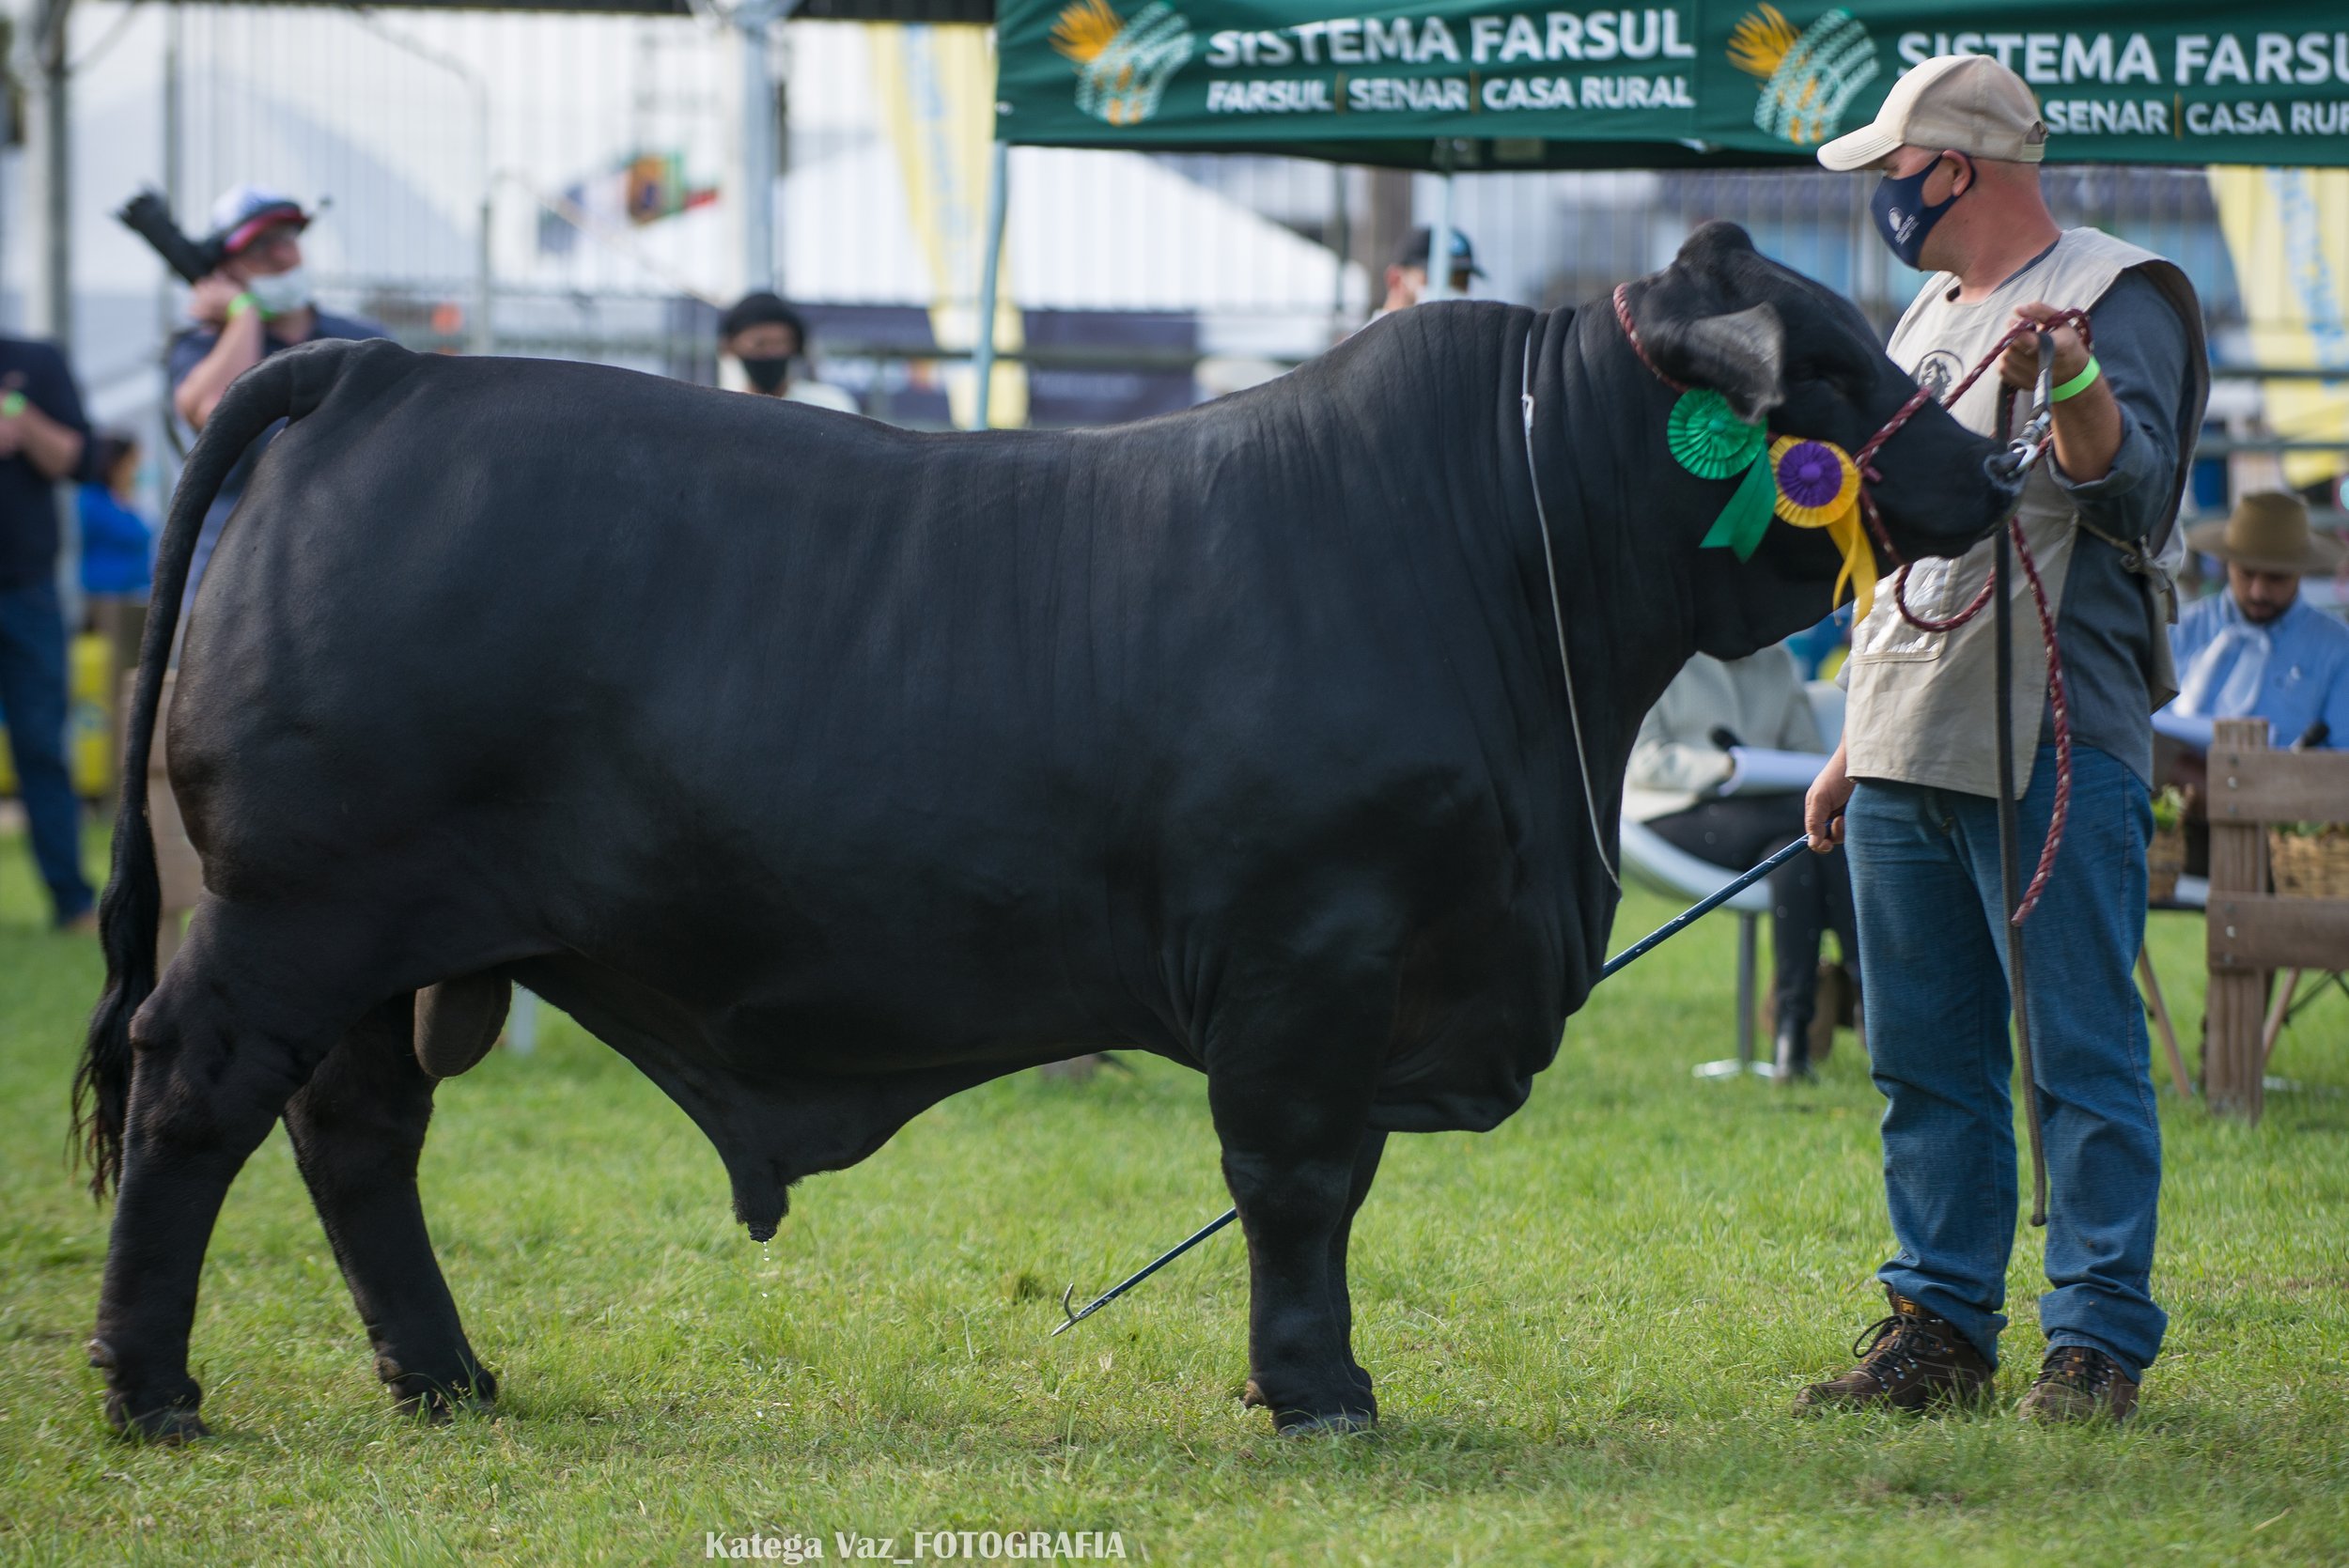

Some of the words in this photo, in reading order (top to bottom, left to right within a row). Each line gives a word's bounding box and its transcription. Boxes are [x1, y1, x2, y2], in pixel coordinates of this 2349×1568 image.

[1206, 16, 1461, 67] SISTEMA
[1470, 9, 1696, 63] FARSUL
[1206, 79, 1334, 113] FARSUL
[1348, 77, 1470, 112] SENAR
[1482, 76, 1578, 111] CASA
[1580, 75, 1697, 109] RURAL
[2045, 100, 2170, 135] SENAR
[2185, 101, 2284, 135] CASA
